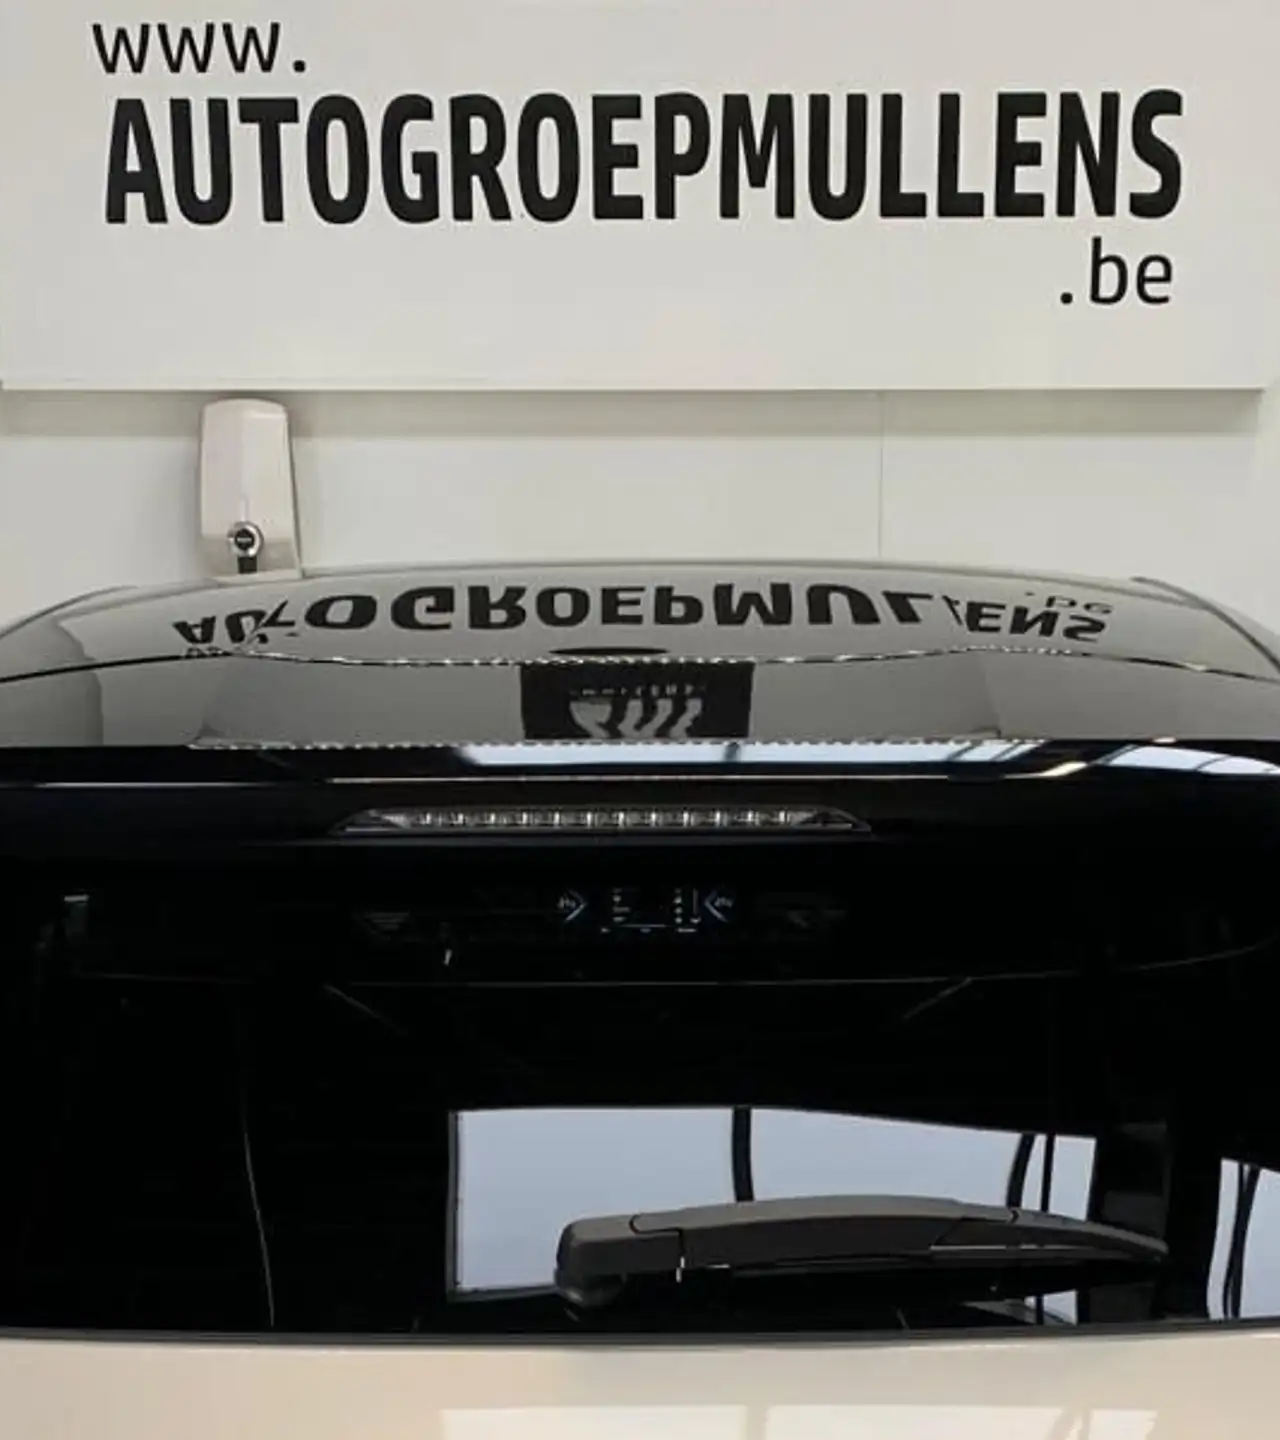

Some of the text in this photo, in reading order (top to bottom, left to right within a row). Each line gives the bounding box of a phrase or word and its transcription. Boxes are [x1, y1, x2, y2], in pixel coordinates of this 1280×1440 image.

[92, 22, 306, 74] www.
[105, 89, 1183, 225] AUTOGROEPMULLENS
[1060, 236, 1172, 305] .be
